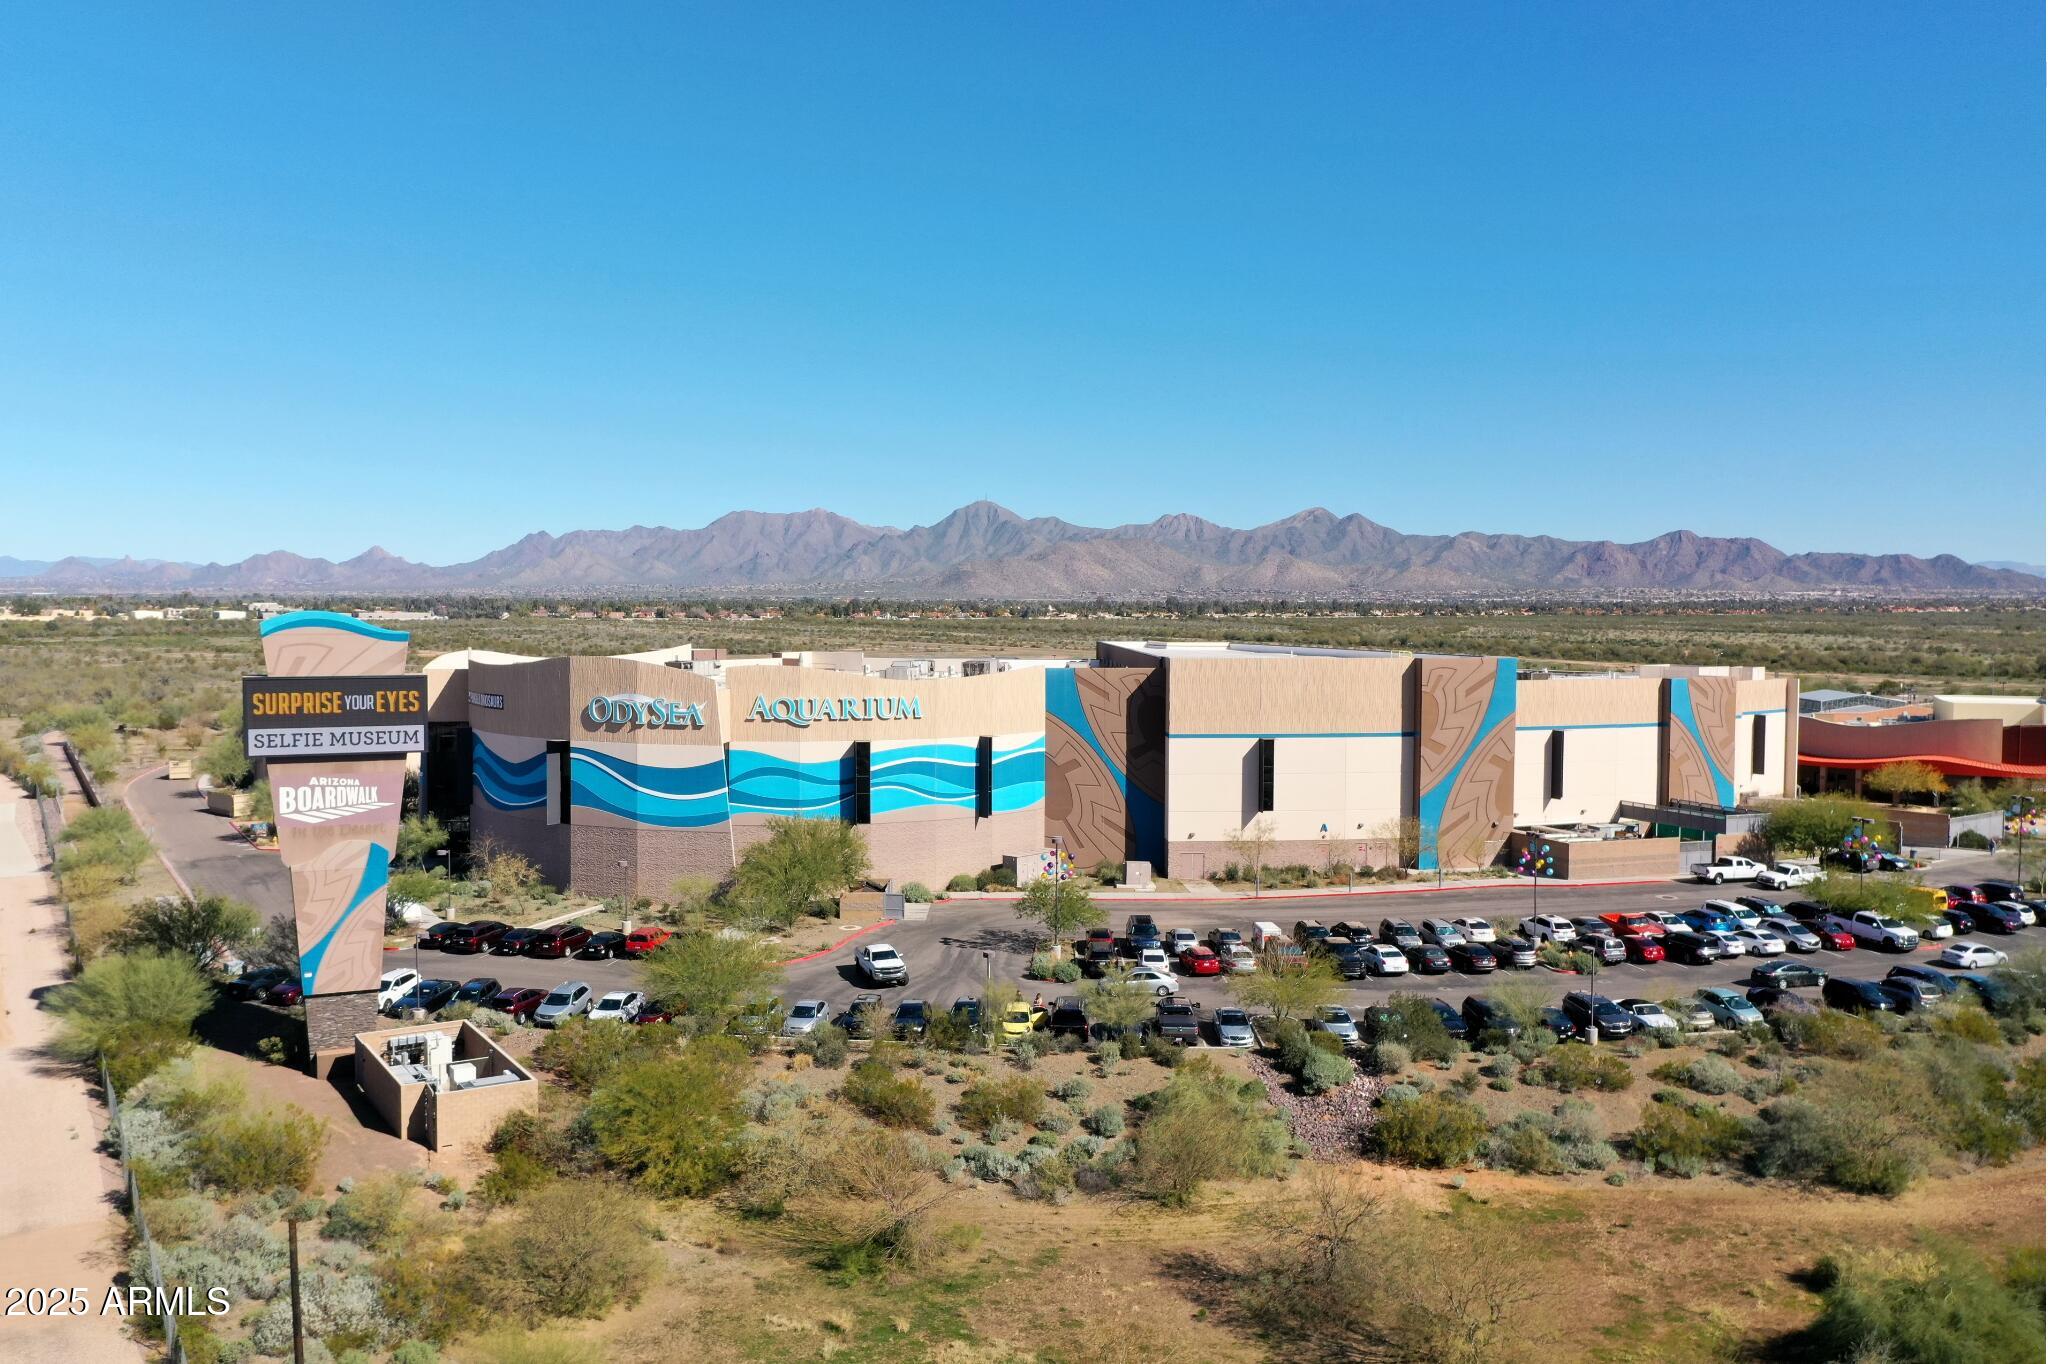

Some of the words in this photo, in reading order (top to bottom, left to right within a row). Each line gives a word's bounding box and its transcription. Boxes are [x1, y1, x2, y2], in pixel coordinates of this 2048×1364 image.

[252, 691, 343, 716] SURPRISE
[344, 694, 375, 711] YOUR
[375, 690, 421, 713] EYES
[747, 694, 923, 726] AQUARIUM
[253, 732, 324, 749] SELFIE
[329, 729, 420, 747] MUSEUM
[308, 776, 360, 786] ARIZONA
[279, 786, 378, 814] BOARDWALK
